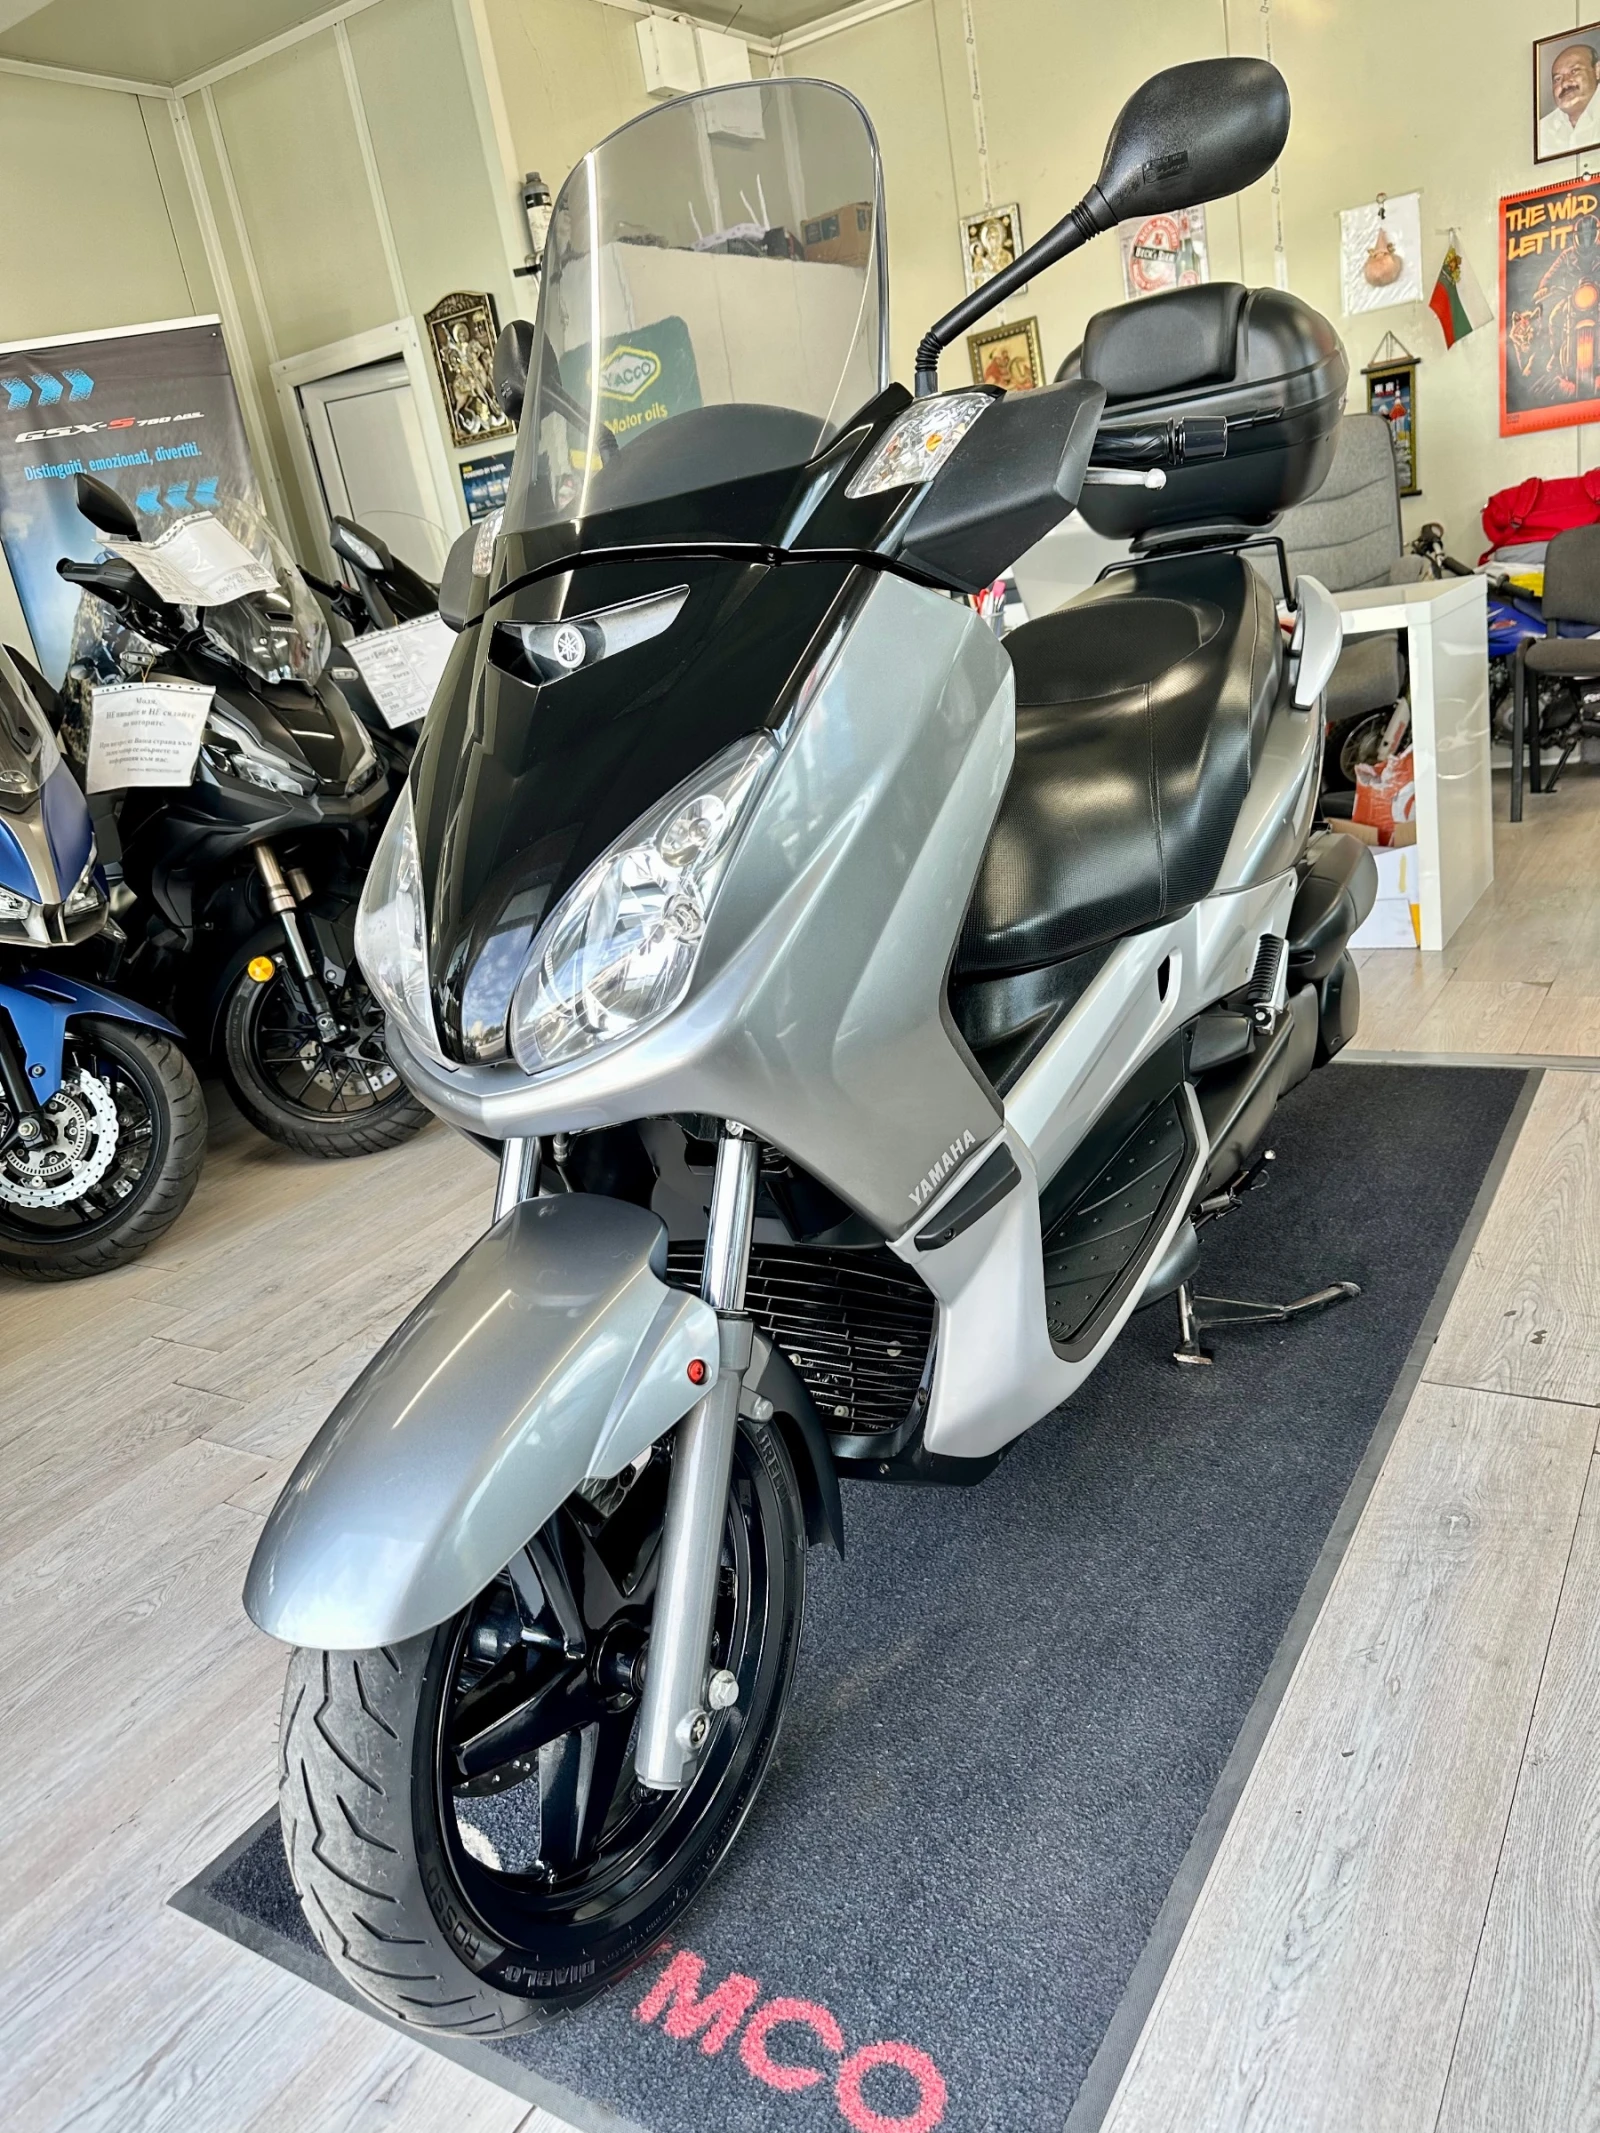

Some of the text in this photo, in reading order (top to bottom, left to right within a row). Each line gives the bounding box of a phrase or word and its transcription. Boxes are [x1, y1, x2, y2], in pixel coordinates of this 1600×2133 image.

[1506, 193, 1598, 232] THE WILD
[1508, 225, 1574, 261] LET IT
[604, 361, 652, 387] YACCO
[644, 401, 669, 421] oils
[15, 416, 136, 443] GSX-S
[24, 441, 203, 481] Distinguiti, emozionati, divertiti.
[270, 626, 299, 634] HONDA
[908, 1129, 976, 1206] YAMAHA
[426, 1868, 481, 1960] ROSSO
[504, 1959, 596, 1987] DIABLO
[615, 1942, 948, 2133] MCO
